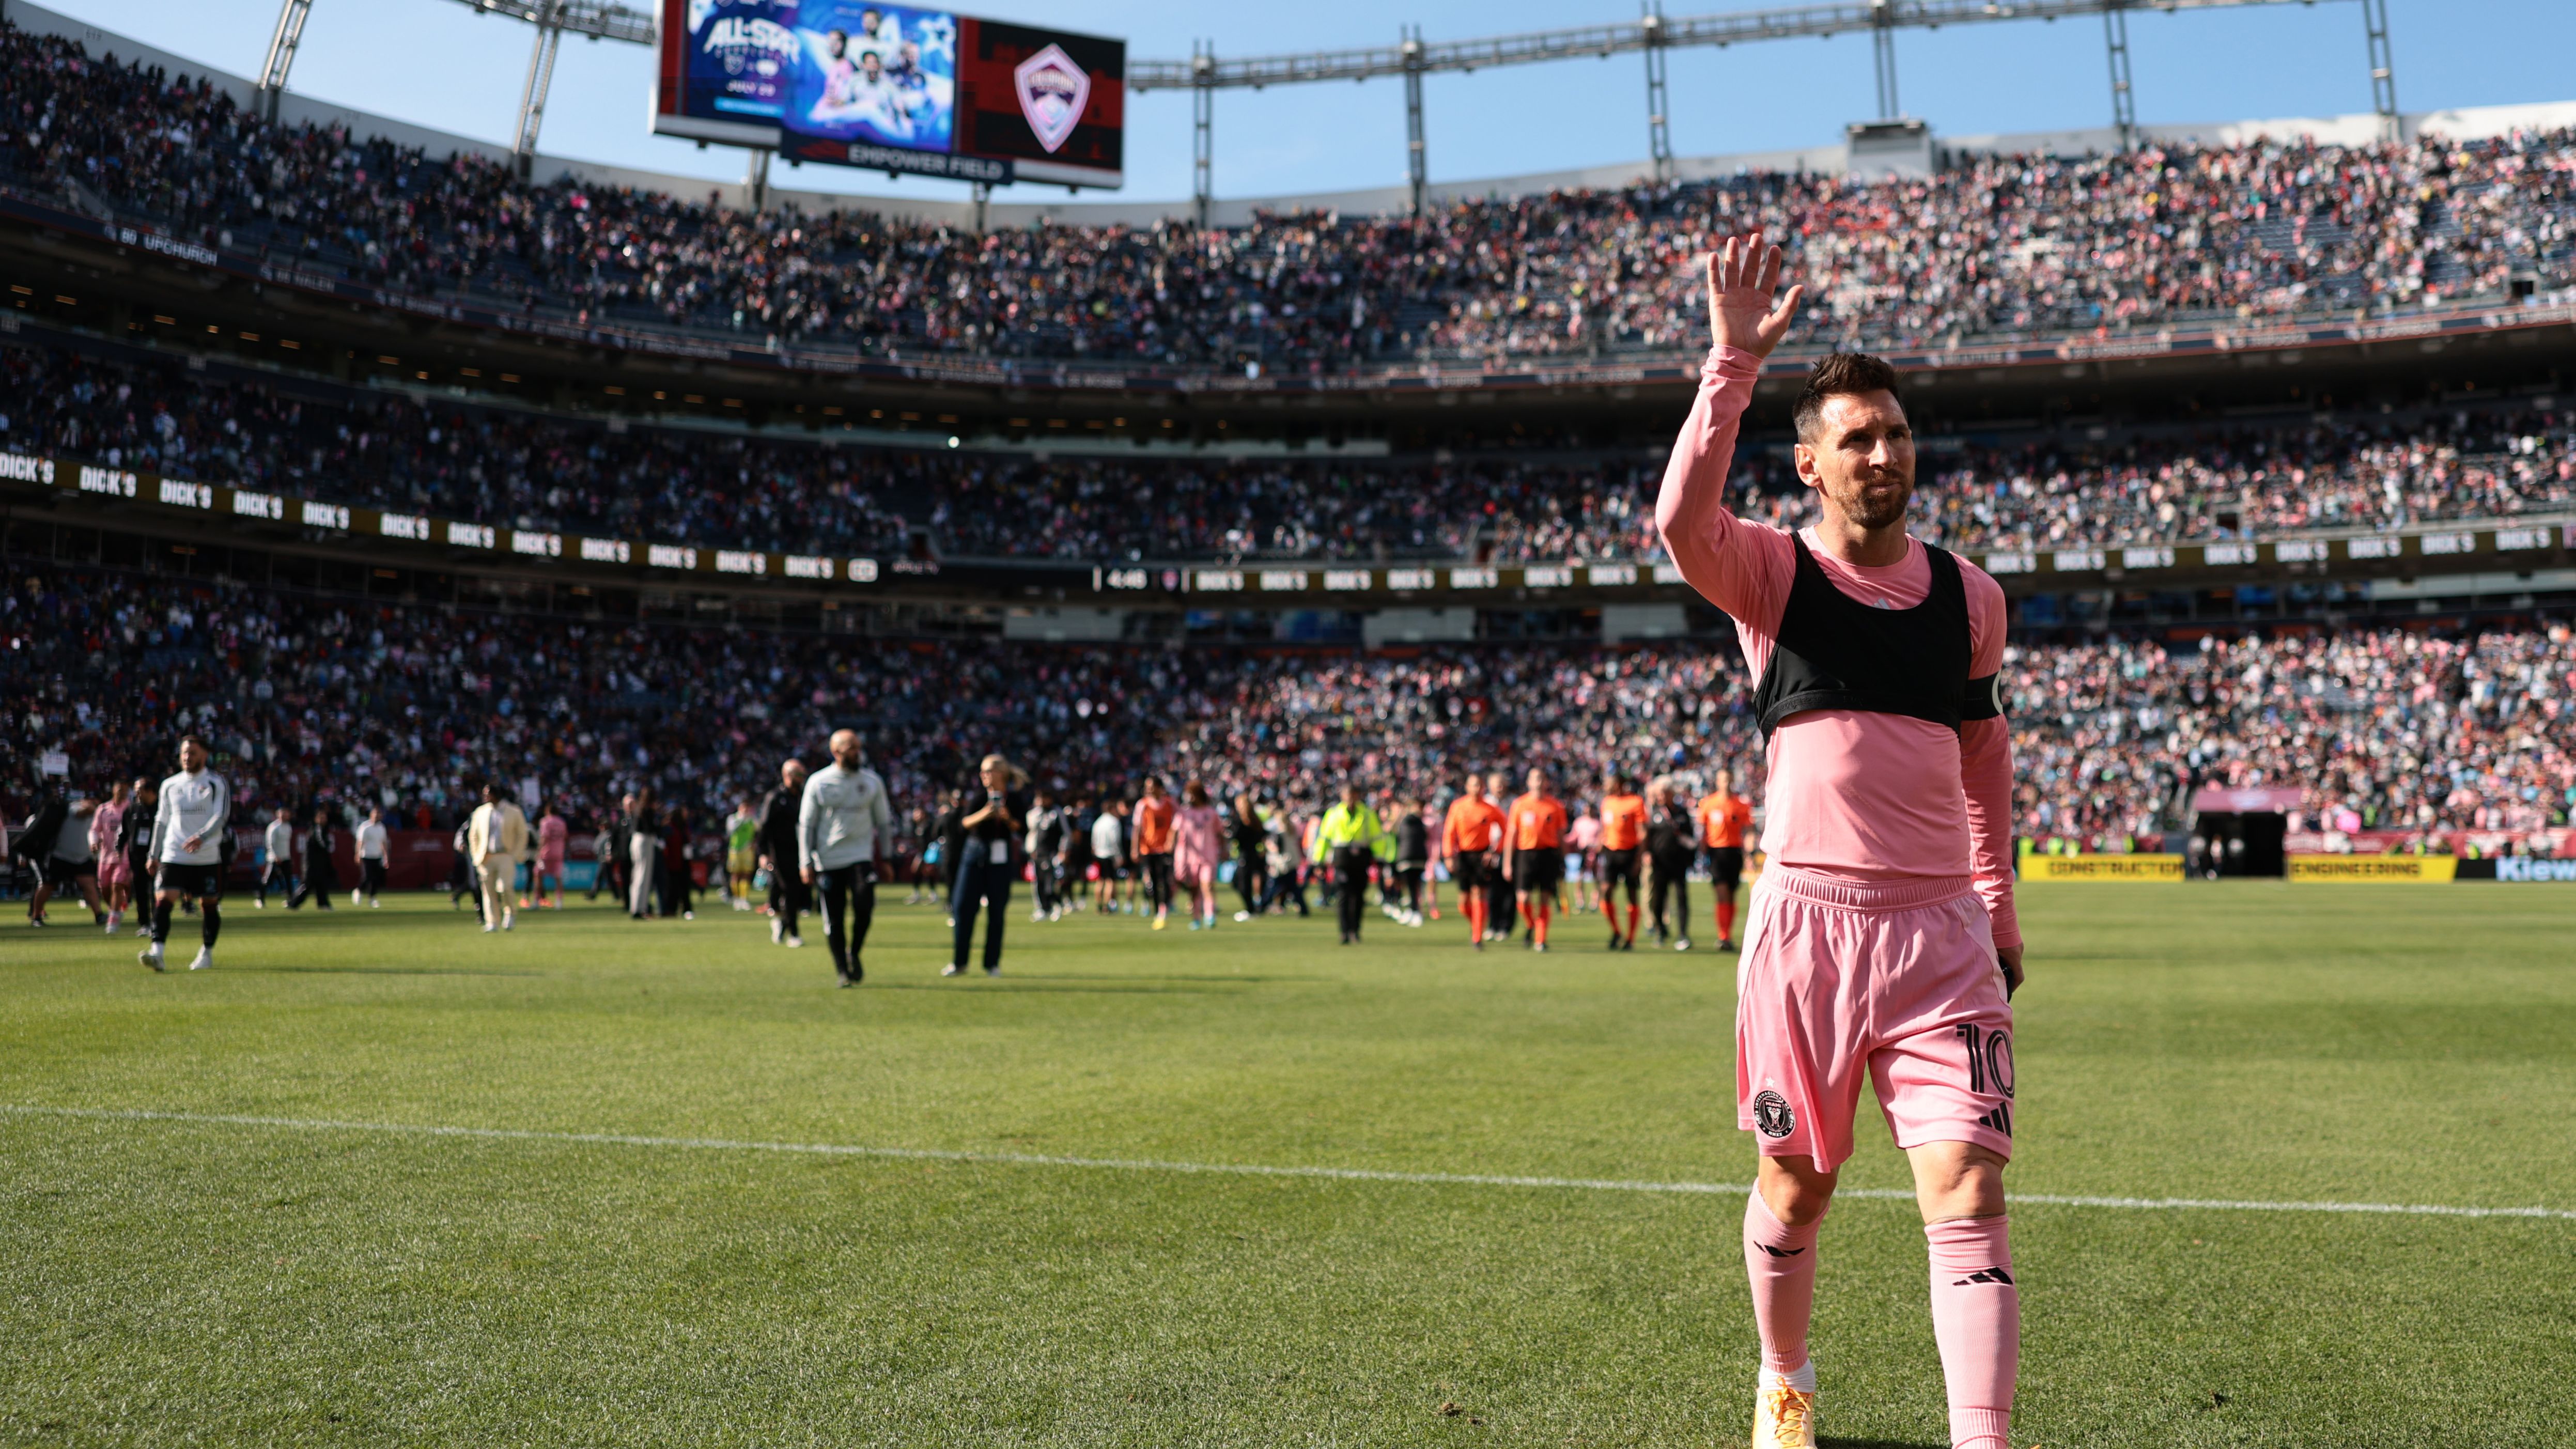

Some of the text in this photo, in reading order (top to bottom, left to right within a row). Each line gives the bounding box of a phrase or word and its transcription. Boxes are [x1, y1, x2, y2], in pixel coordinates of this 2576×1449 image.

[847, 145, 1004, 180] EMPOWER FIELD
[0, 452, 55, 485] DICK'S
[79, 465, 136, 497] DICK'S
[159, 478, 212, 509] DICK'S
[233, 490, 283, 520] DICK'S
[302, 501, 350, 529] DICK'S
[380, 512, 430, 540] DICK'S
[447, 522, 495, 549] DICK'S
[511, 531, 562, 557] DICK'S
[580, 537, 630, 563] DICK'S
[648, 544, 697, 569] DICK'S
[715, 550, 767, 574] DICK'S
[784, 555, 834, 579] DICK'S
[2292, 861, 2423, 876] ENGINEERING
[1956, 1023, 2015, 1099] 10
